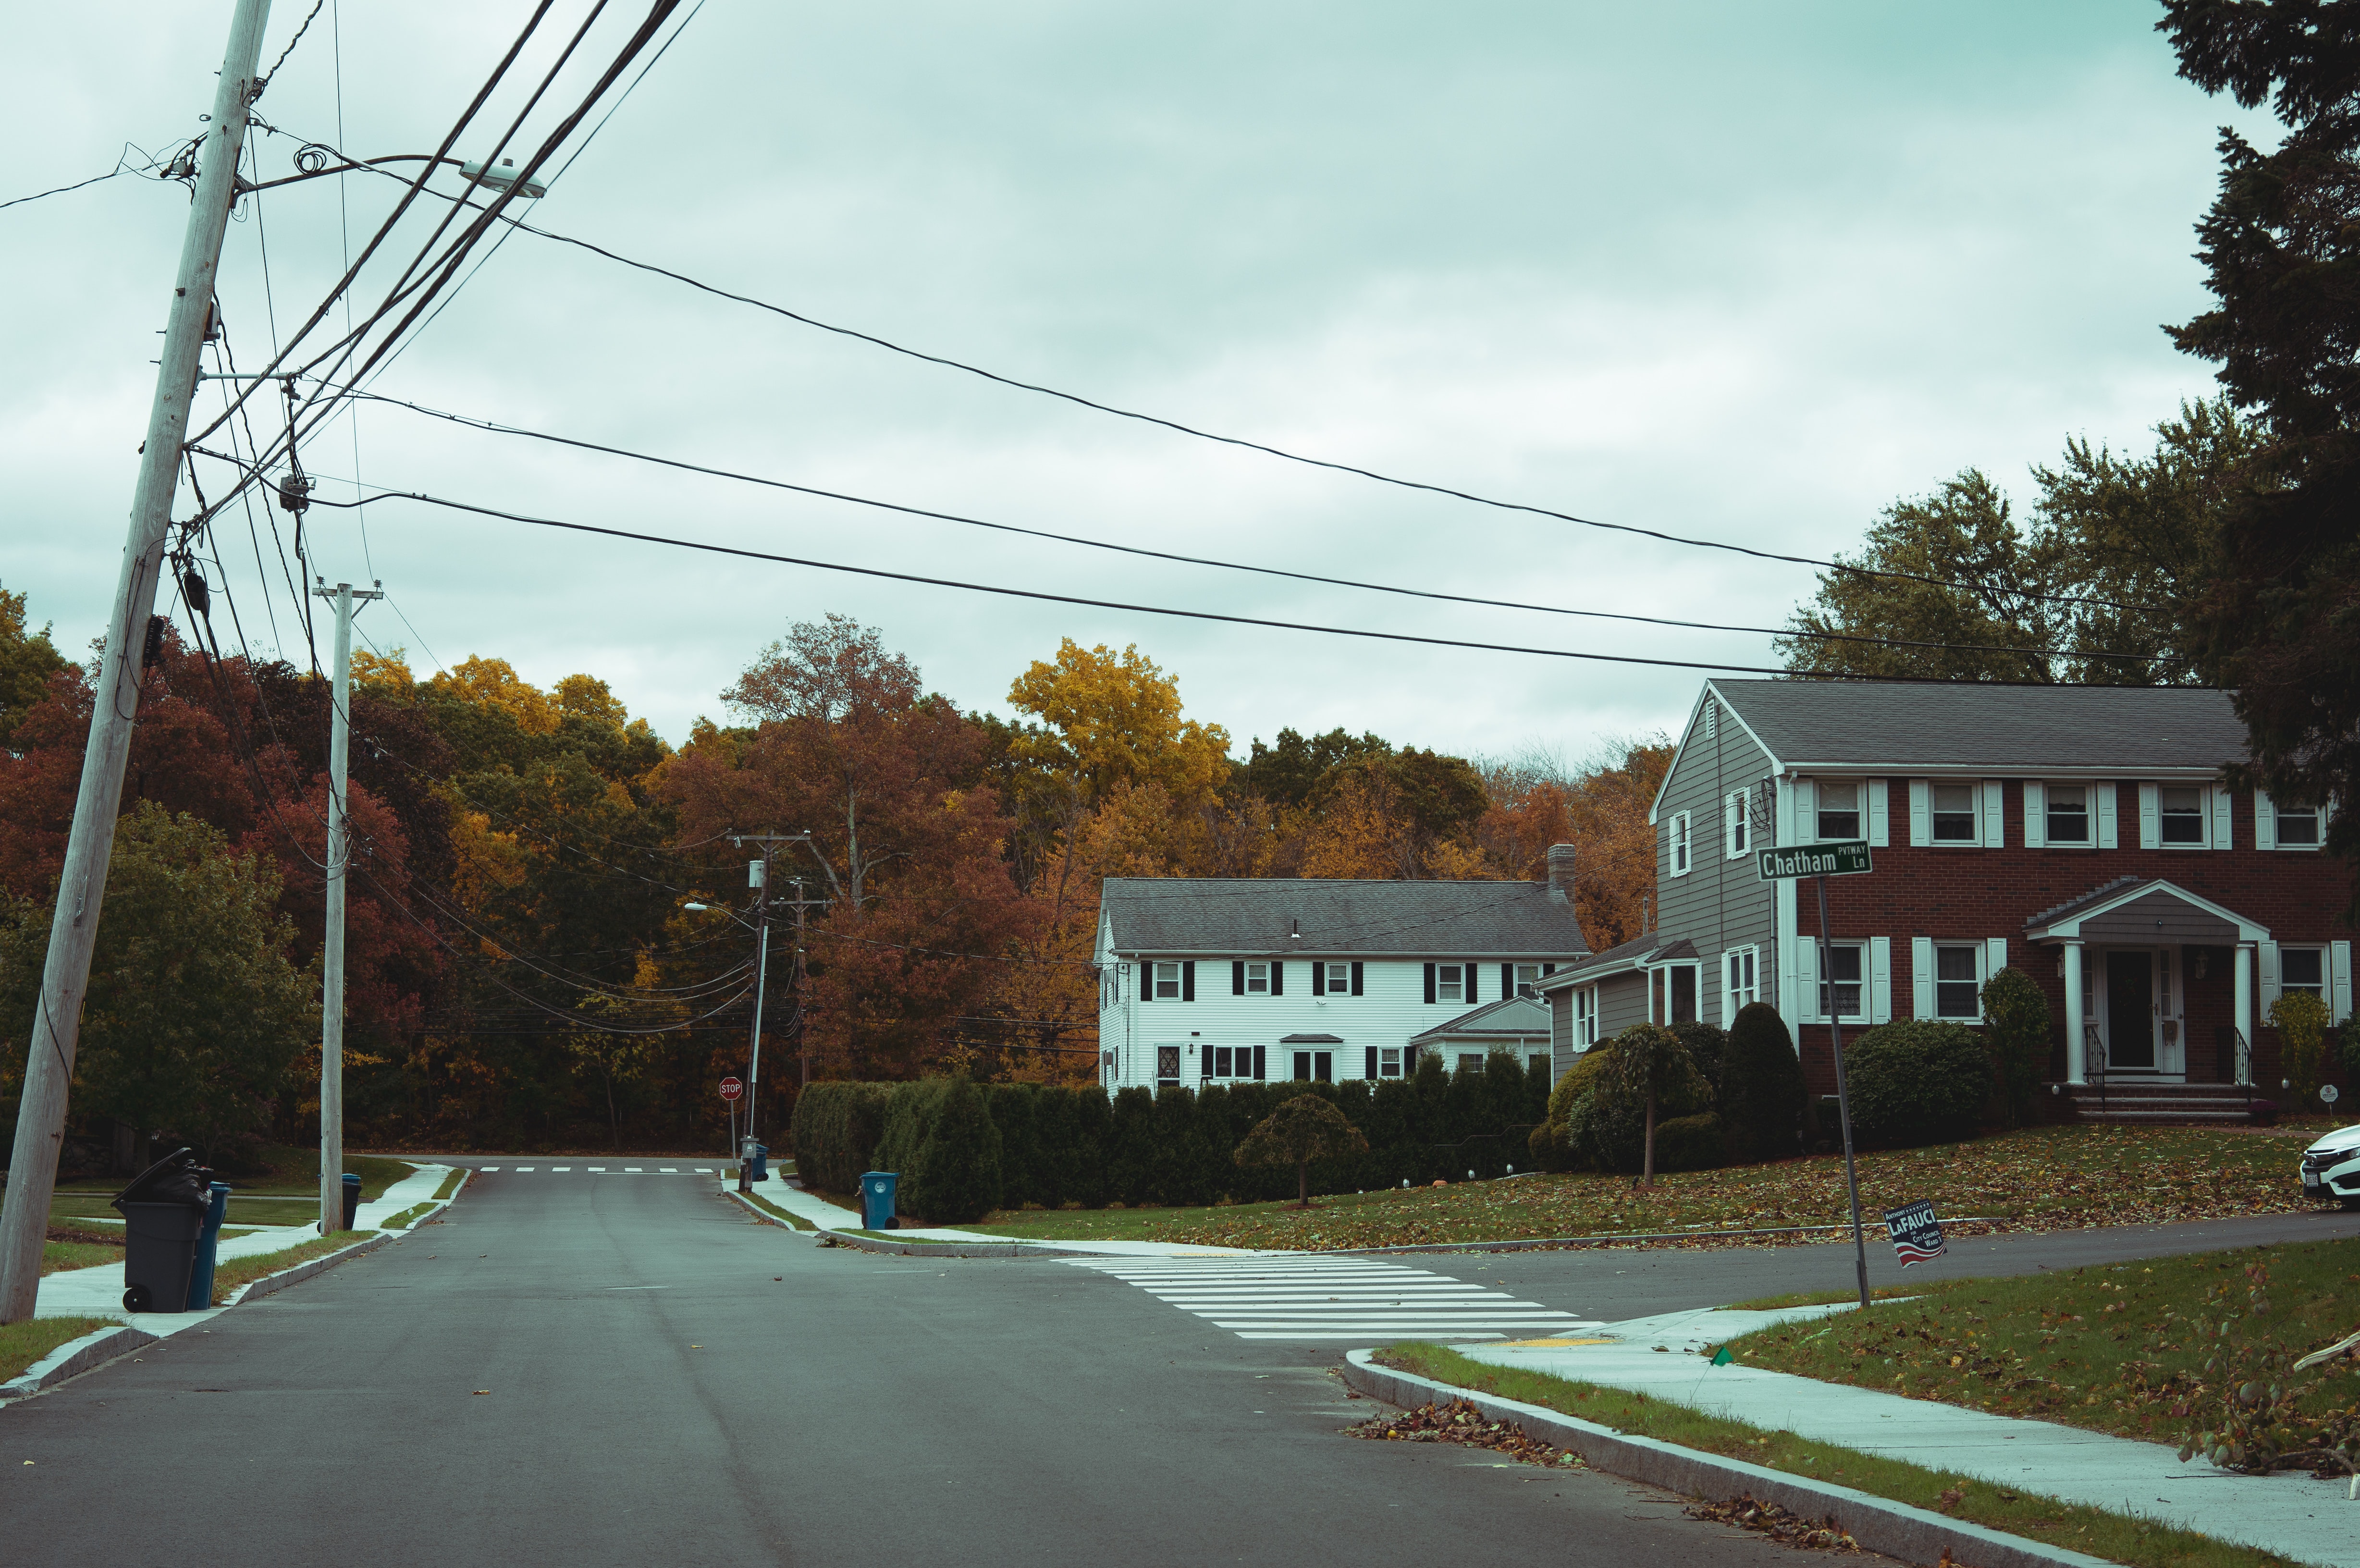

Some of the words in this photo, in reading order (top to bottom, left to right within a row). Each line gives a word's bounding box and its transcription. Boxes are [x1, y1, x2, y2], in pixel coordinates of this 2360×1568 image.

[1763, 851, 1836, 876] Chatham
[1853, 856, 1865, 868] Ln
[722, 1084, 740, 1093] STOP
